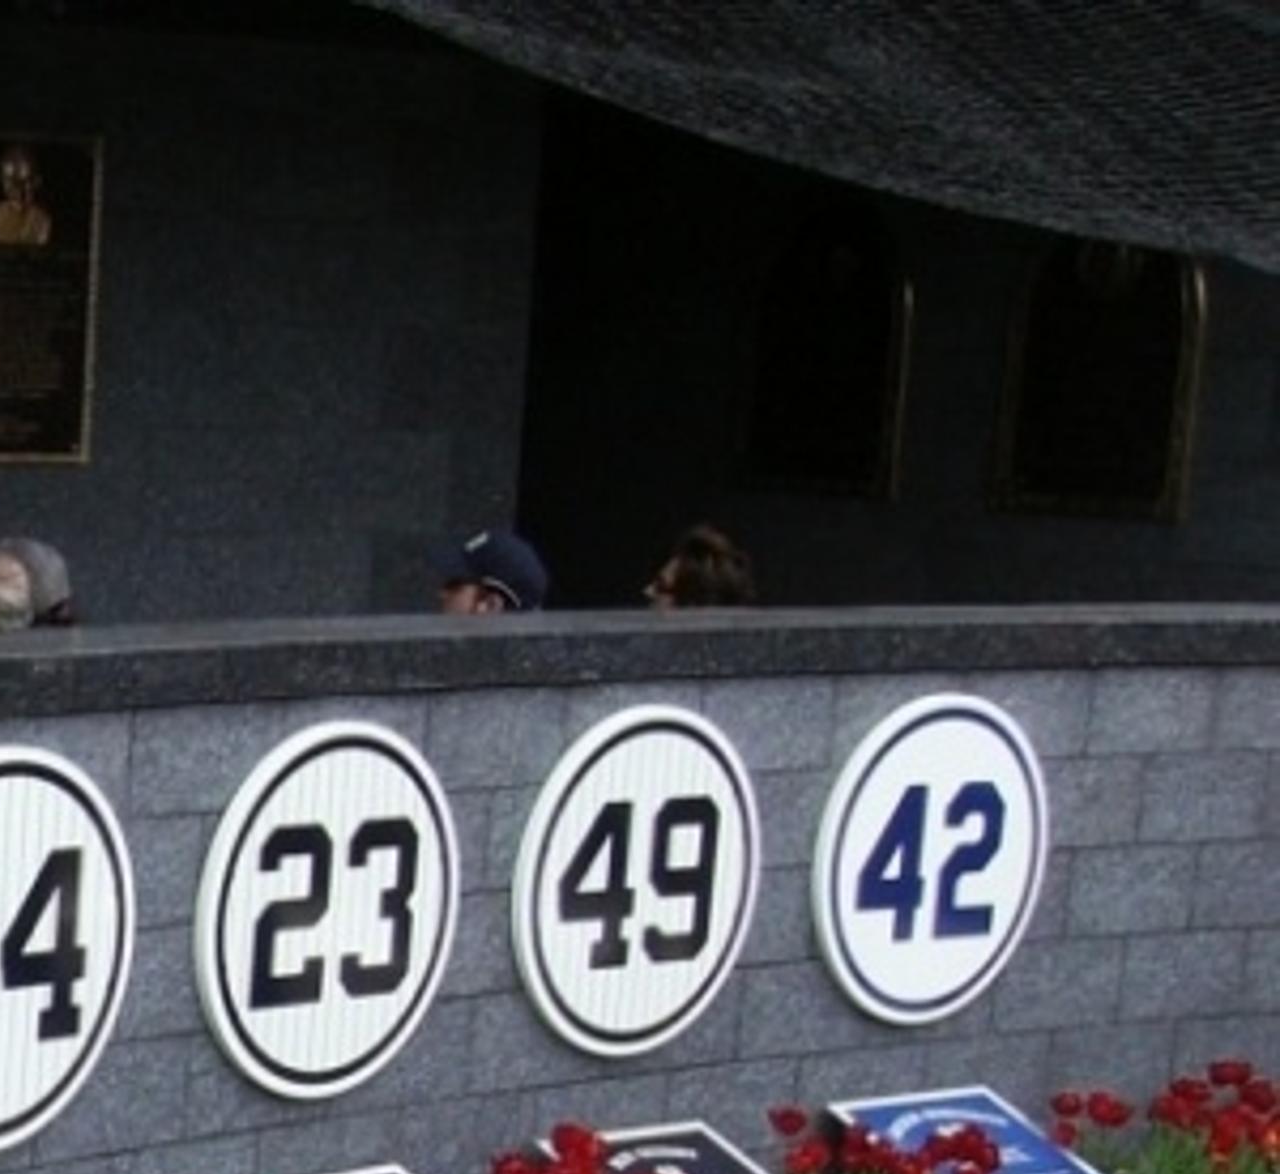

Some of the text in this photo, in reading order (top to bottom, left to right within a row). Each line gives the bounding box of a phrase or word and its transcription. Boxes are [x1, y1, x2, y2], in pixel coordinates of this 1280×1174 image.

[250, 818, 418, 1008] 23
[560, 796, 719, 968] 49
[858, 782, 1004, 939] 42
